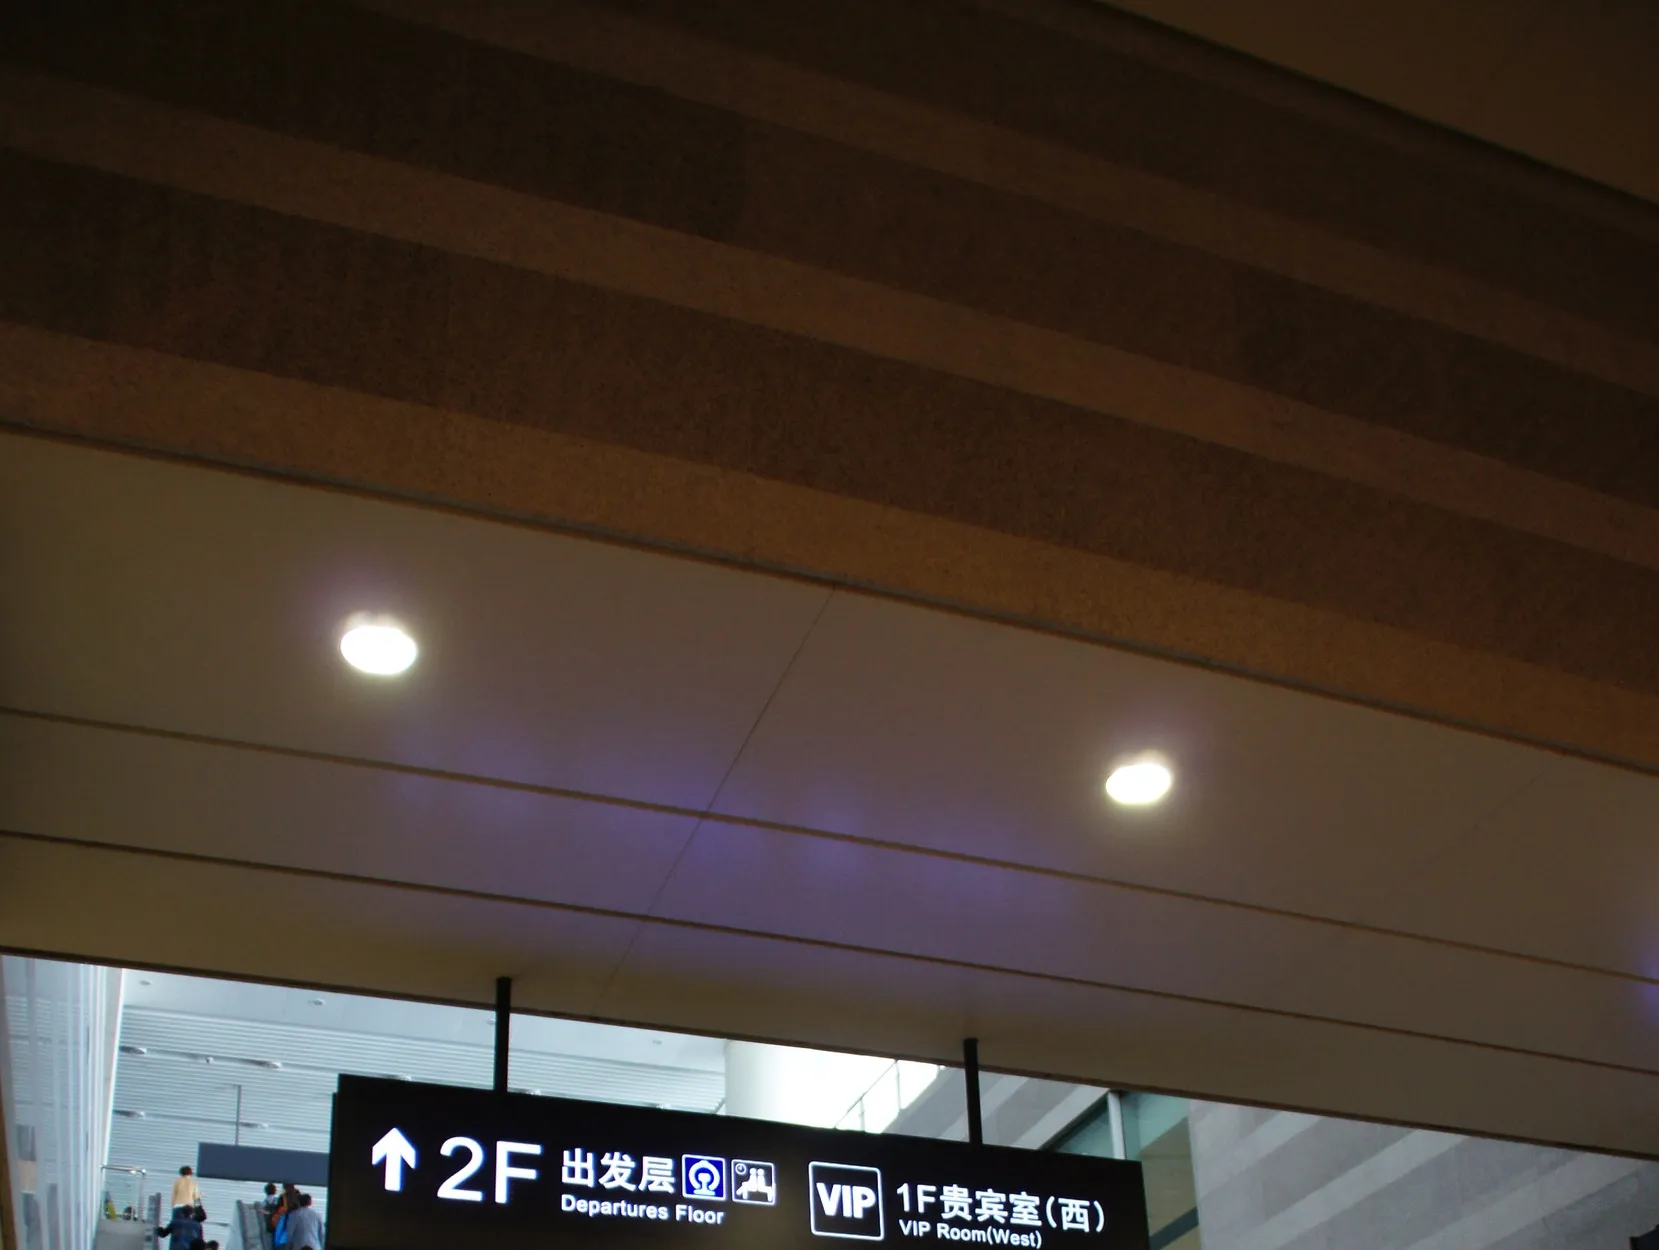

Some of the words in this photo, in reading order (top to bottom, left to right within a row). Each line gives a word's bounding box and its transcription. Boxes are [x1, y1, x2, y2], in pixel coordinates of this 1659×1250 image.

[437, 1137, 542, 1203] 2F
[561, 1147, 676, 1195] 出发层
[561, 1194, 670, 1221] Departures
[675, 1203, 725, 1225] Floor
[815, 1182, 877, 1219] VIP
[899, 1218, 932, 1237] VIP
[936, 1222, 1042, 1250] Room(West)
